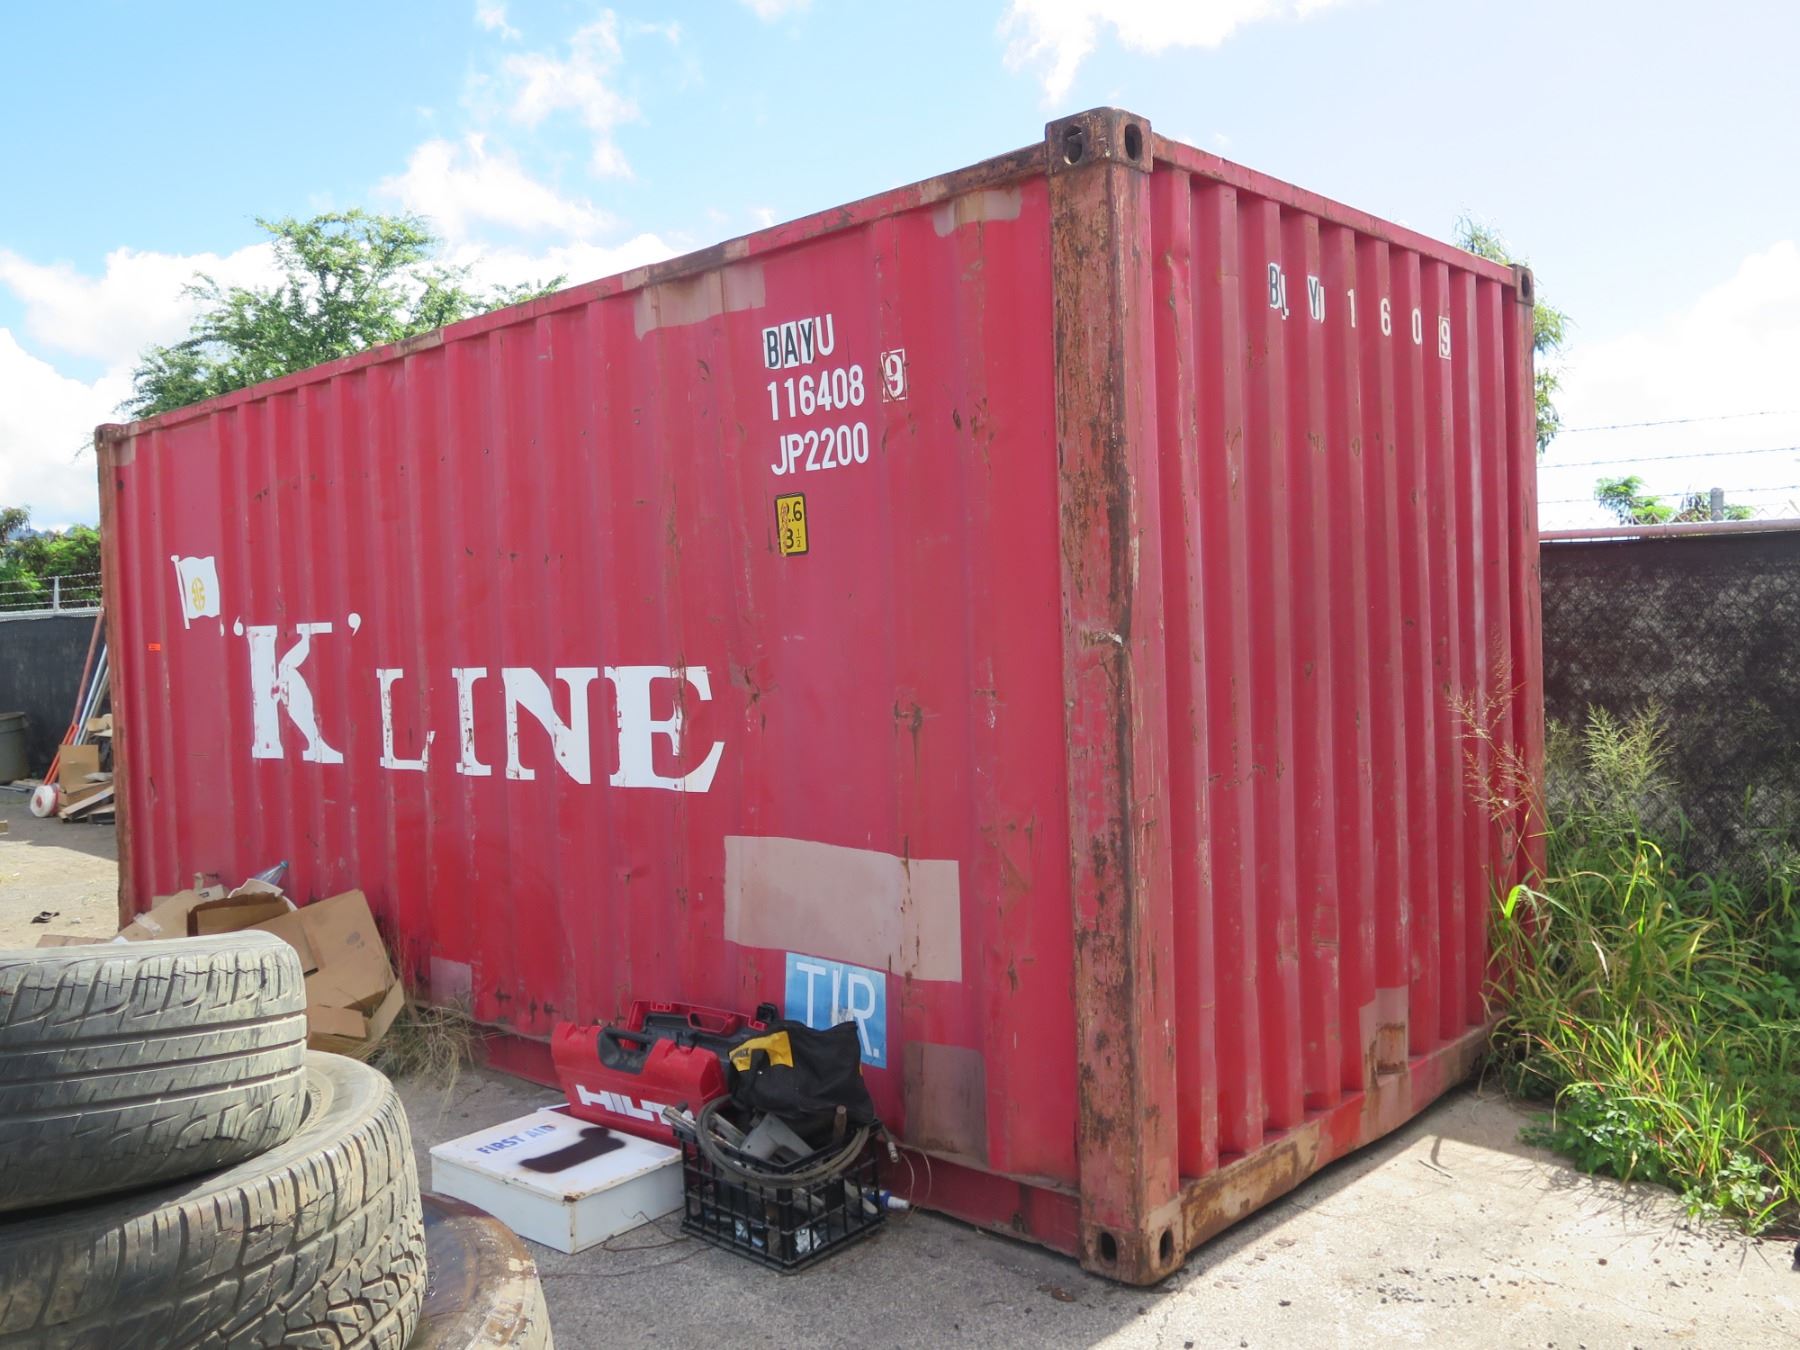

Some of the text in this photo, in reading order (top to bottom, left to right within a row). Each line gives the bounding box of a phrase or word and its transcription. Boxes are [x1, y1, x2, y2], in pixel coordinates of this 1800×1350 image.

[764, 314, 835, 369] BAYU
[767, 353, 905, 421] 116408 9
[771, 421, 869, 475] JP2200
[376, 665, 726, 792] LINE
[476, 1135, 525, 1154] FIRST
